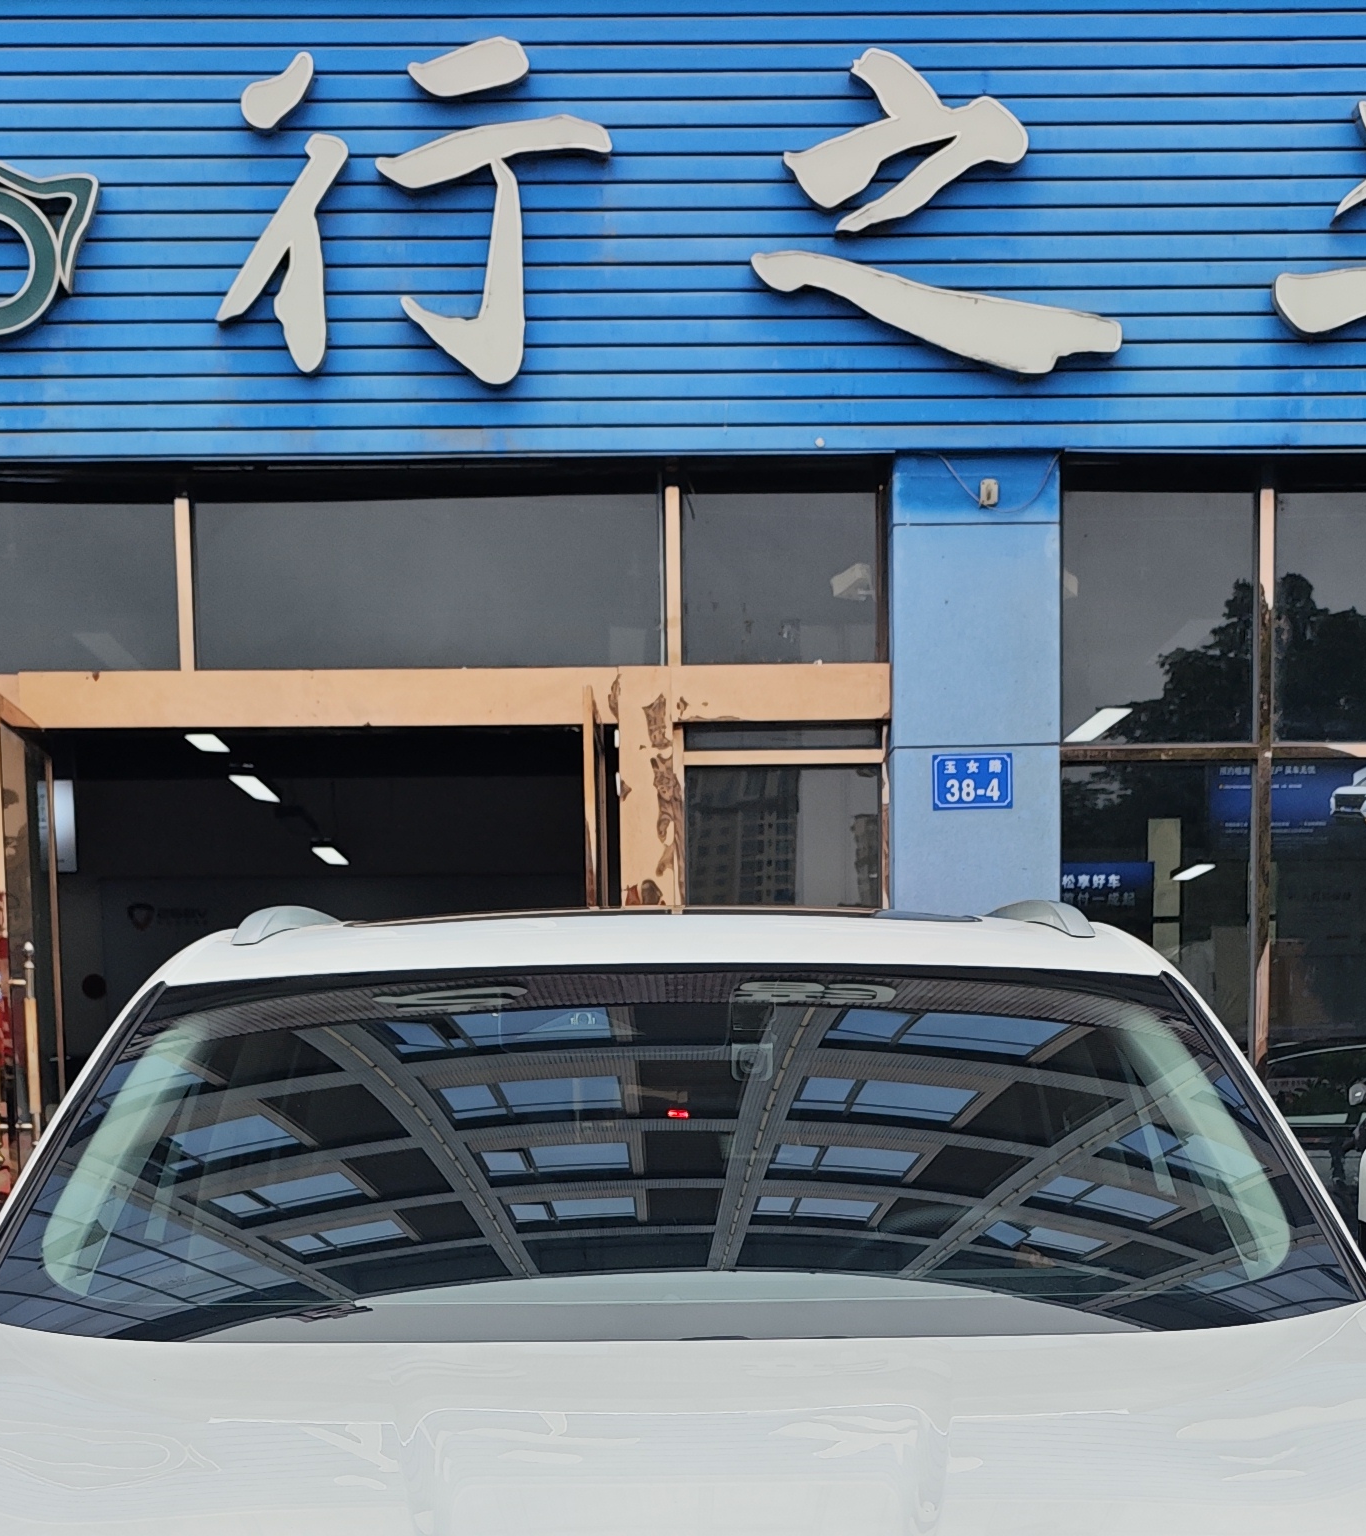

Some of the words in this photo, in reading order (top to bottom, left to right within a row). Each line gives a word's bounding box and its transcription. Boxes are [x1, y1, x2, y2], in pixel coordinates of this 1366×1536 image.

[944, 759, 1002, 774] 玉女路
[946, 778, 1001, 802] 38-4
